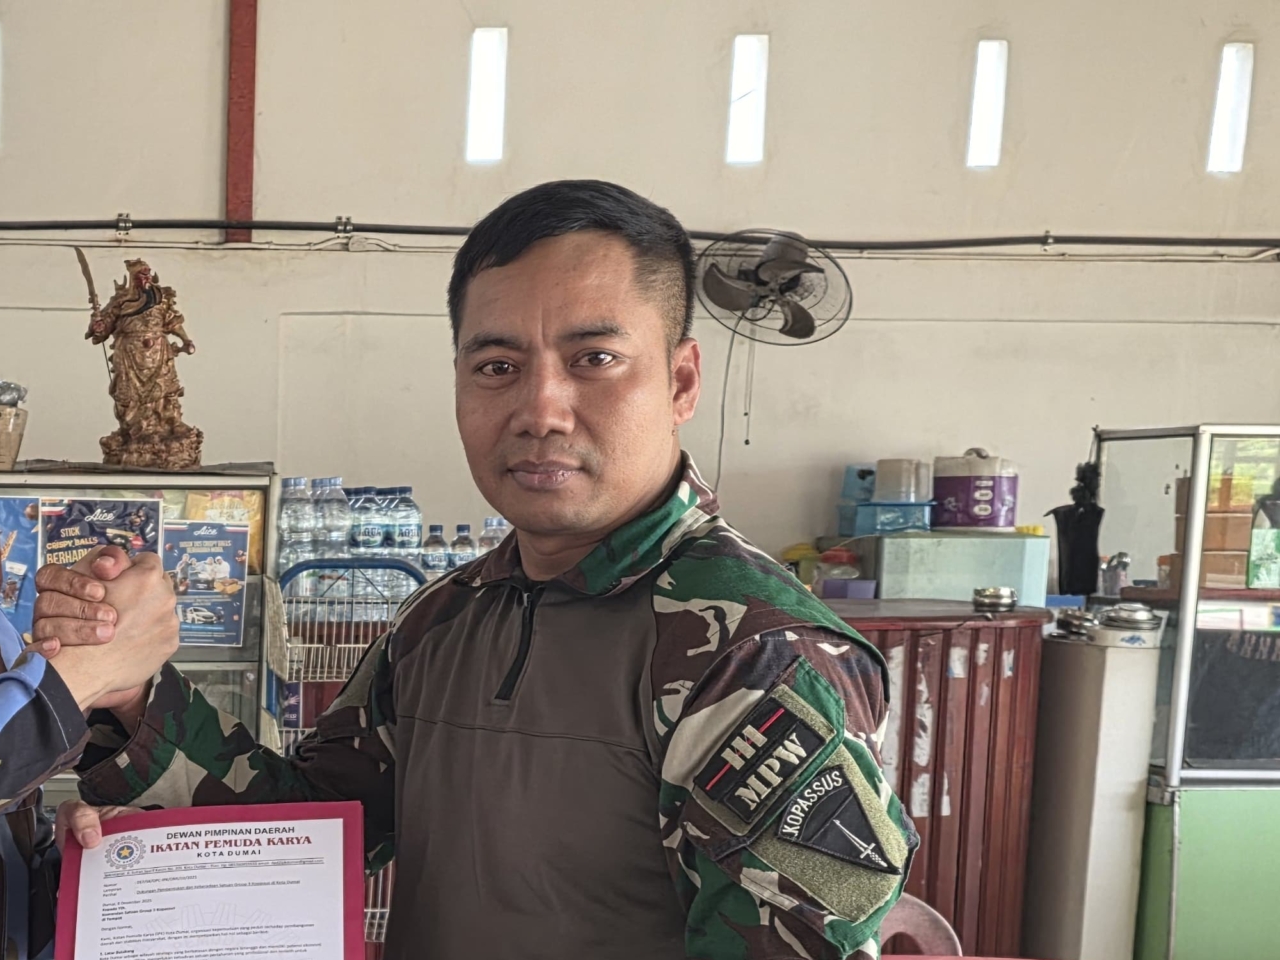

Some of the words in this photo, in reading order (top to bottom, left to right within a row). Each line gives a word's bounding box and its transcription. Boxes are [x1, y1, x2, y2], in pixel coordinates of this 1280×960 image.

[84, 508, 115, 522] Aice
[60, 526, 81, 538] STICK
[46, 539, 73, 549] CRISPY
[74, 536, 99, 546] BALLS
[734, 732, 807, 811] MPW
[782, 771, 843, 837] KOPASSUS
[166, 830, 202, 840] DEWAN
[204, 828, 252, 837] PIMPINAN
[254, 826, 295, 835] DAERAH
[150, 841, 200, 854] IKATAN
[204, 838, 262, 849] PEMUDA
[266, 835, 312, 846] KARYA
[227, 849, 261, 857] DUMAI
